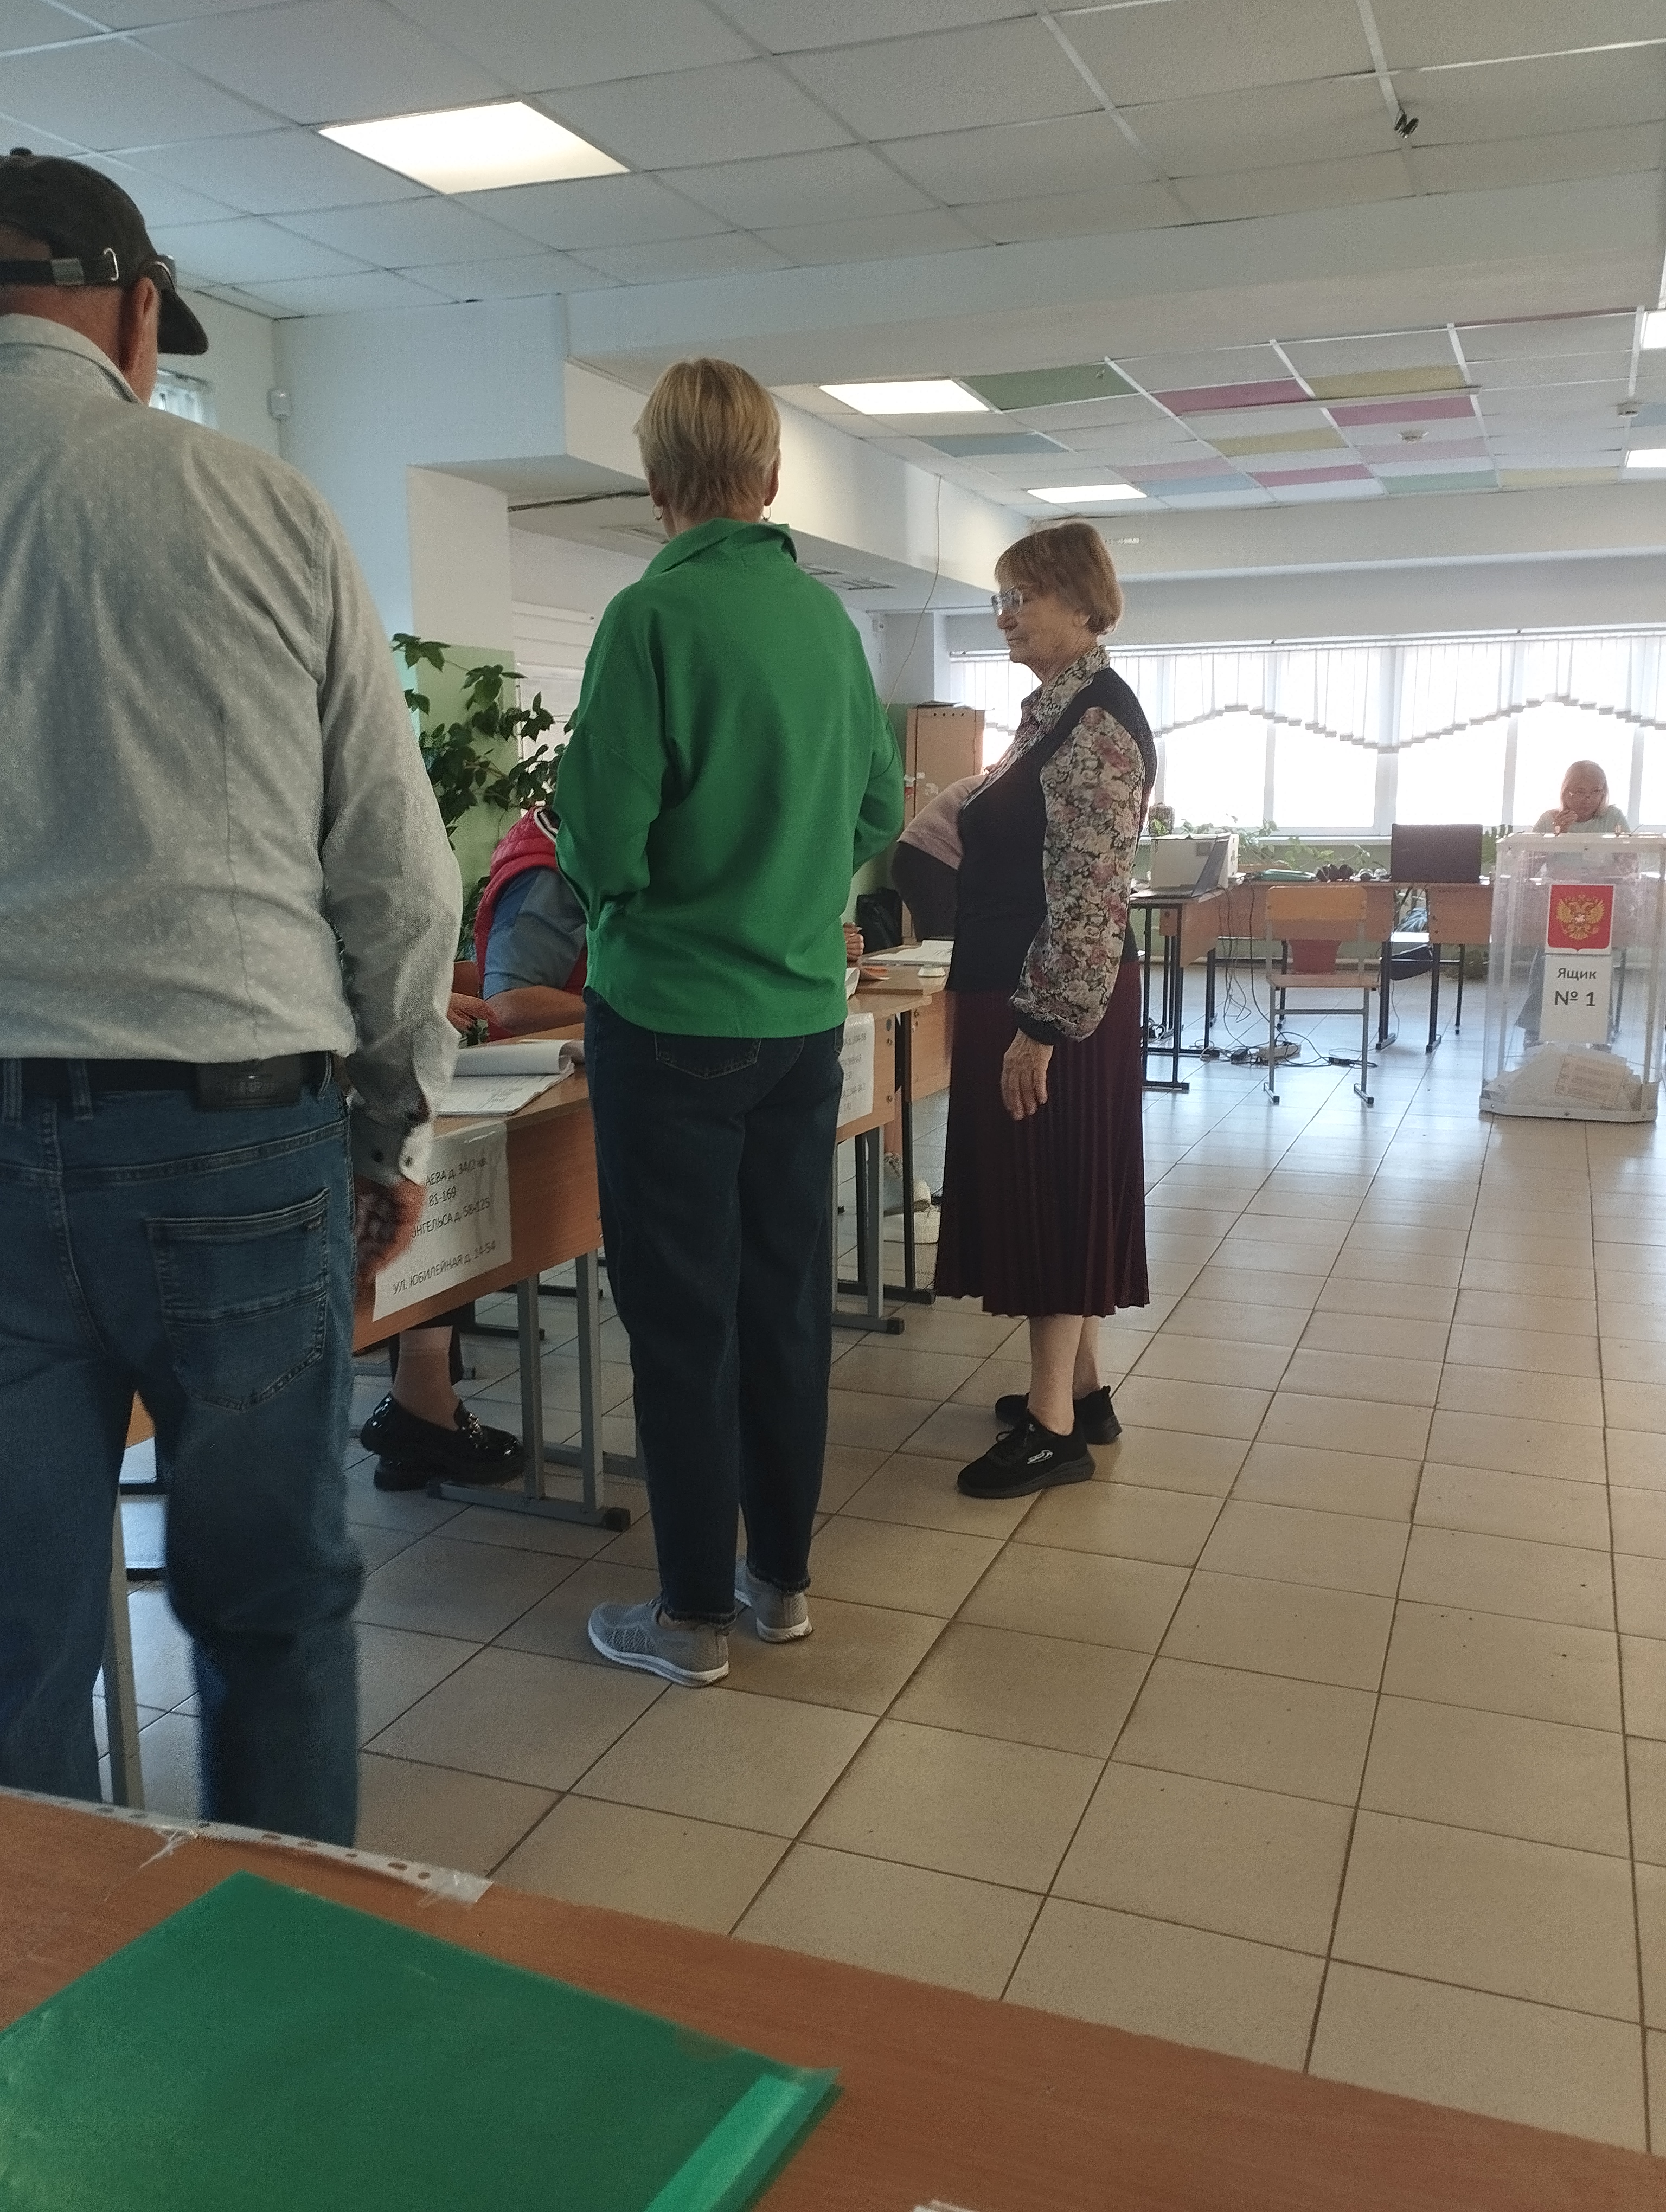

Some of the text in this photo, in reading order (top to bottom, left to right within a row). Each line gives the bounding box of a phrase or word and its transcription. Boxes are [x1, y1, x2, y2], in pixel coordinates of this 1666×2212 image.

[1557, 967, 1597, 981] Ящик
[1555, 991, 1595, 1007] № 1
[425, 1169, 447, 1186] АЕВА
[428, 1186, 457, 1207] 81-169
[393, 1279, 408, 1295] УЛ.
[409, 1254, 463, 1287] ЮБИЛЕЙНАЯ
